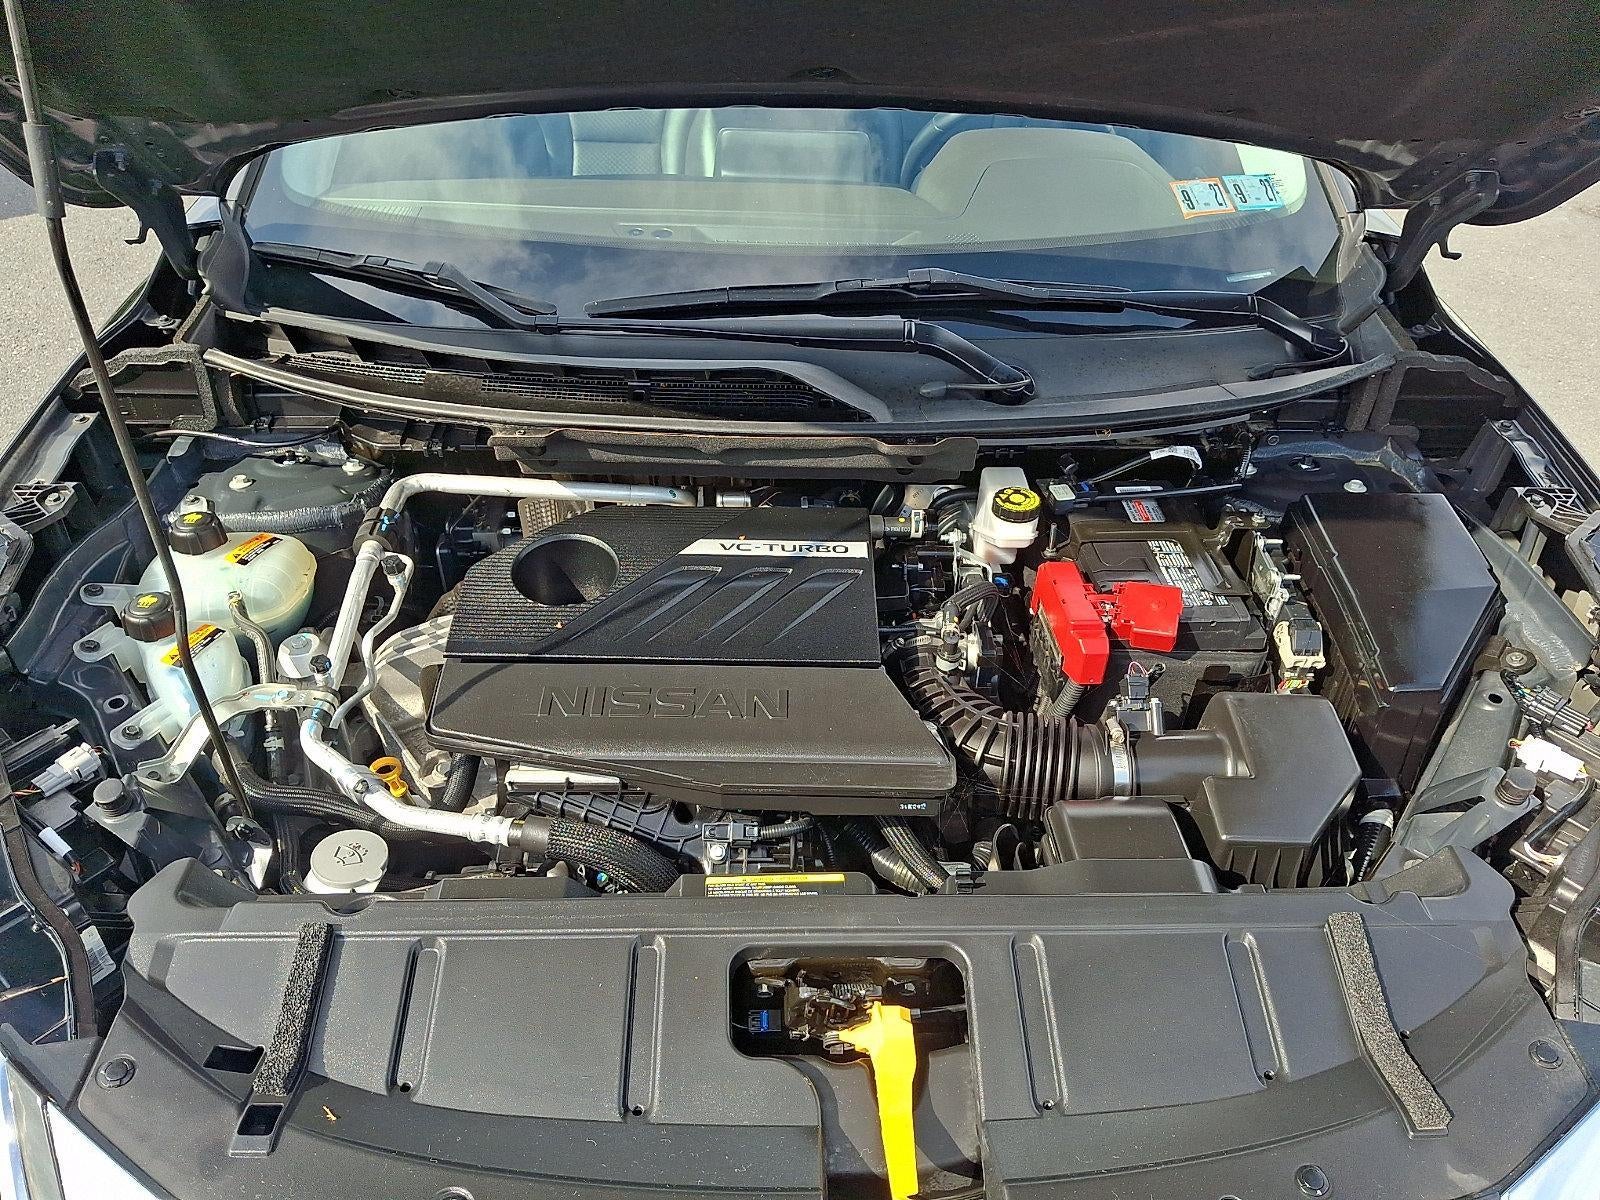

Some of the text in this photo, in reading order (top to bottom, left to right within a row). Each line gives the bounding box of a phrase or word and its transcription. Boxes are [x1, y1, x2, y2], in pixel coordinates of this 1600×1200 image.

[1180, 183, 1228, 210] 9 27
[1233, 178, 1277, 204] 9 27
[718, 542, 850, 554] VC-TURBO
[537, 685, 790, 719] NISSAN
